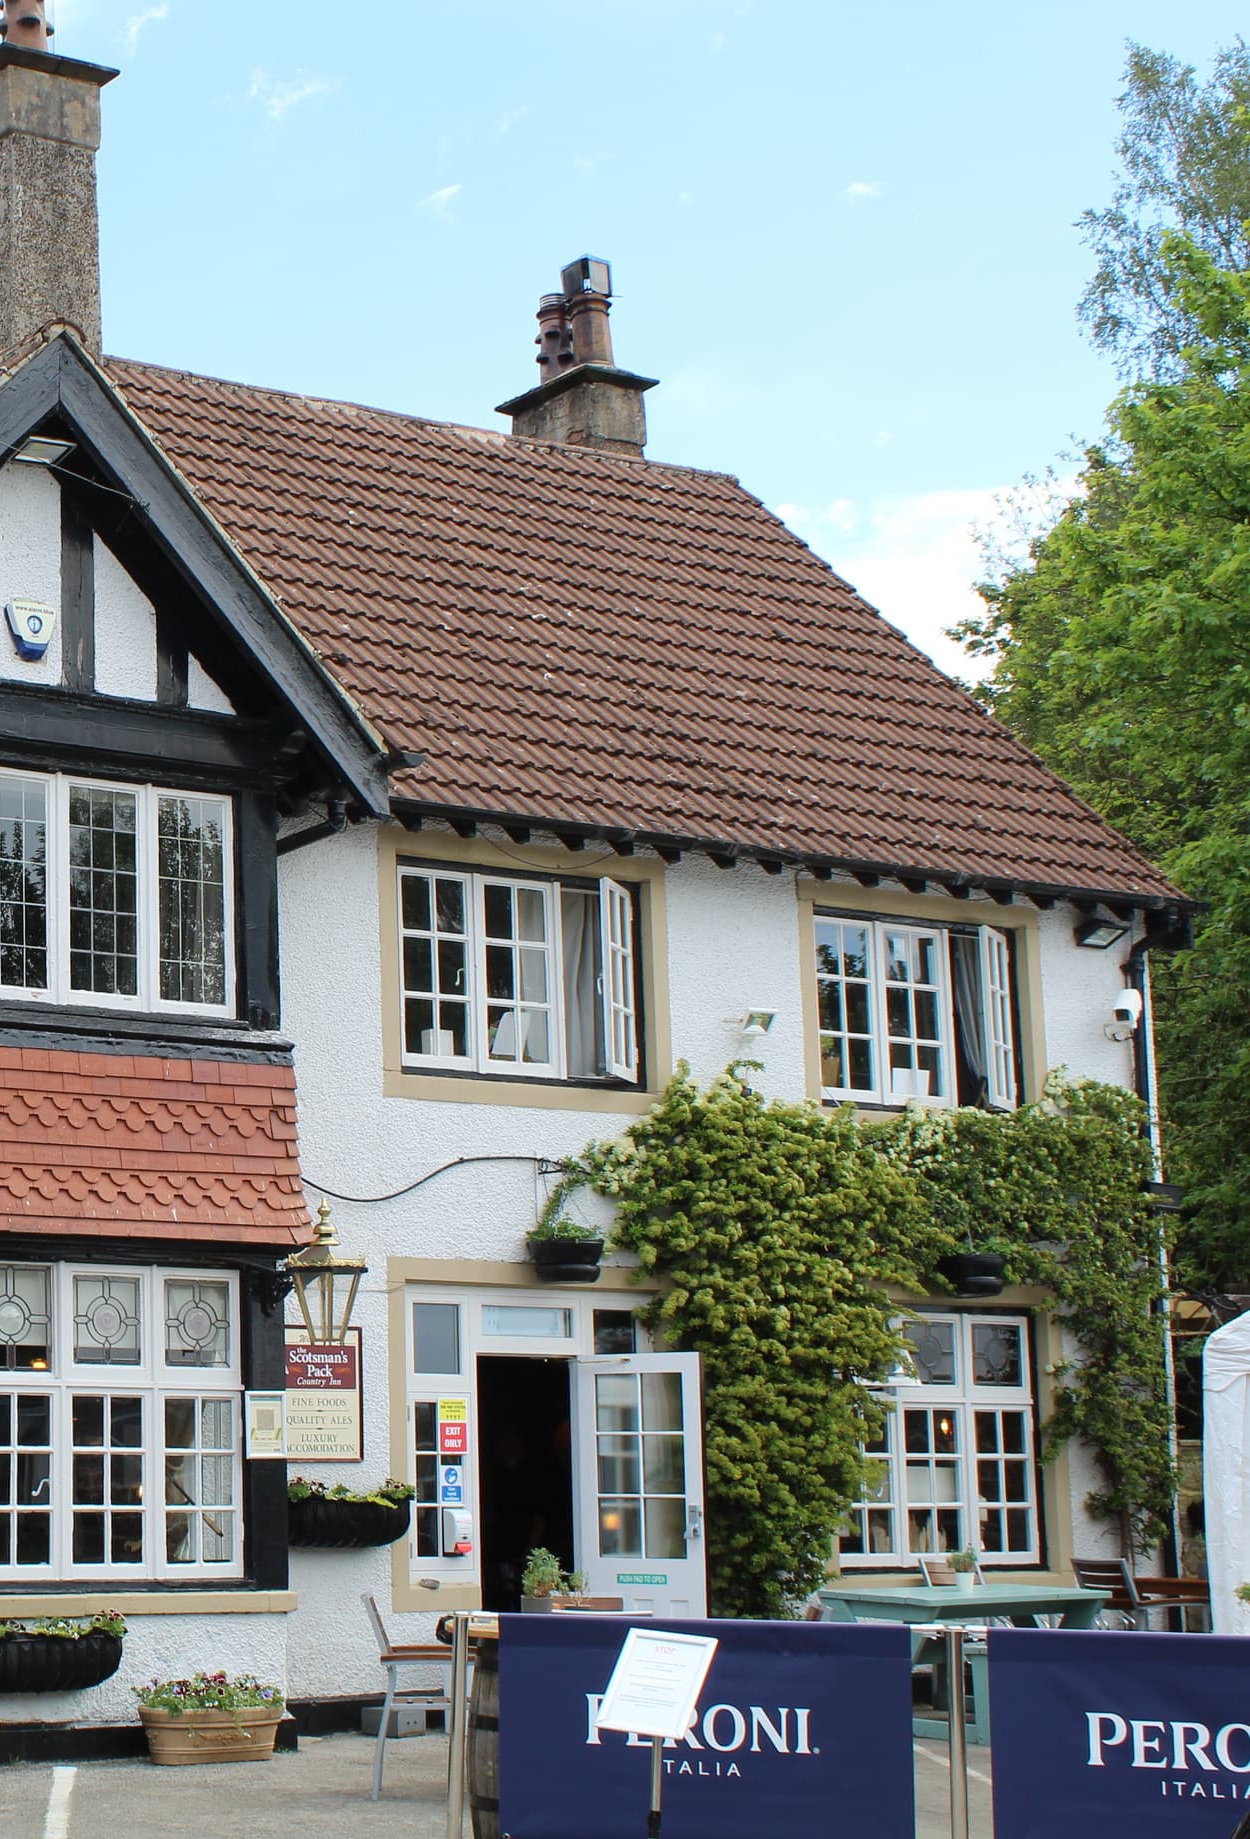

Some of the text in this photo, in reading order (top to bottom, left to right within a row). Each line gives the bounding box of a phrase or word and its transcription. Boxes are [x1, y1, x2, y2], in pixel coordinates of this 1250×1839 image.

[289, 1349, 348, 1364] Scotsman's
[307, 1364, 333, 1377] Pack
[296, 1377, 342, 1387] Country Inn
[292, 1398, 347, 1407] FINE FOODS
[286, 1416, 353, 1425] QUALITY ALES
[445, 1427, 461, 1435] EXIT
[301, 1434, 338, 1442] LUXURY
[444, 1439, 462, 1448] ONLY
[662, 1759, 741, 1778] TALIA
